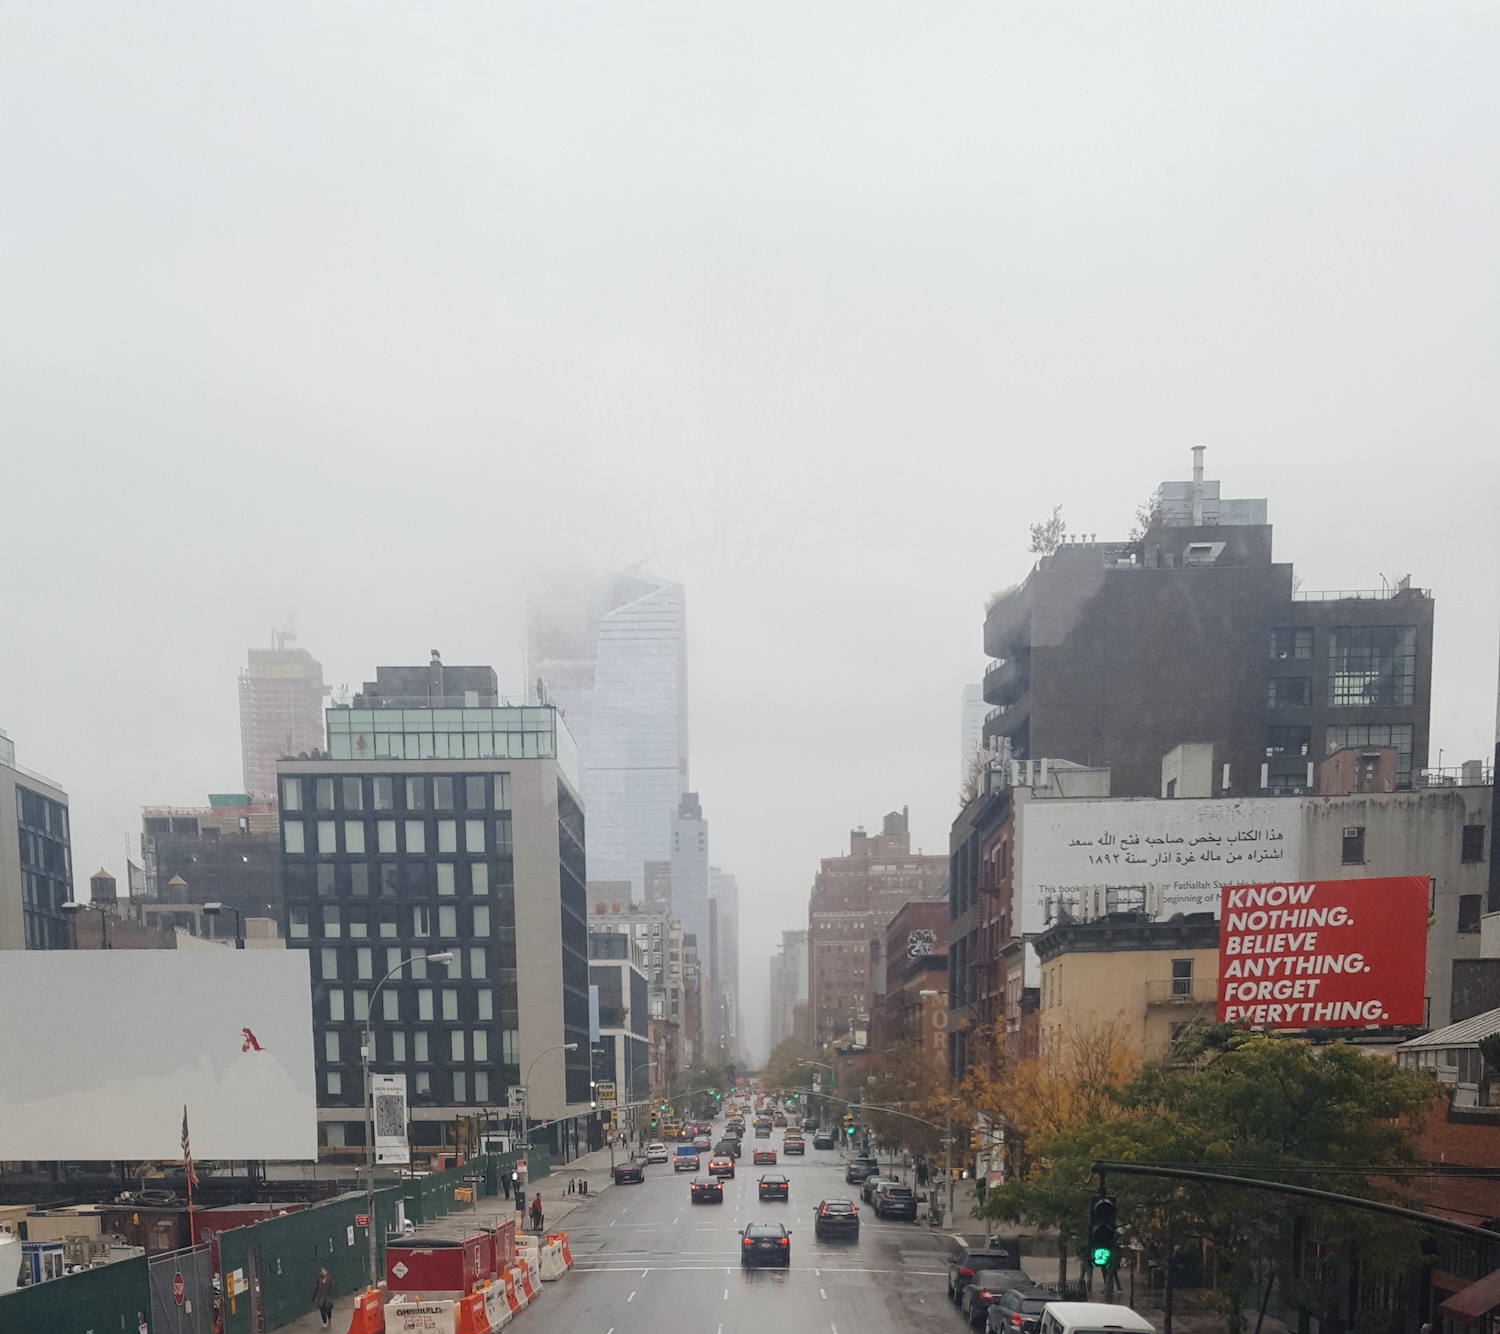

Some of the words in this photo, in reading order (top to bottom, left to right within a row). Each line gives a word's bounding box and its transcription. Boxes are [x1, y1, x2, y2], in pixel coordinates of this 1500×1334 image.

[1189, 832, 1221, 847] يخص
[1227, 829, 1261, 846] الكتاب
[1266, 829, 1283, 841] هذا
[1226, 852, 1242, 864] من
[1038, 884, 1056, 894] This
[1059, 884, 1081, 893] book
[1173, 881, 1211, 891] Fathallah
[1205, 892, 1214, 902] of
[1227, 884, 1316, 909] KNOW
[1226, 906, 1354, 932] NOTHING.
[1226, 932, 1318, 955] BELIEVE
[1224, 953, 1371, 978] ANYTHING.
[1224, 979, 1320, 1001] FORGET
[1225, 1000, 1389, 1023] EVERYTHING.
[173, 1283, 184, 1295] STOP
[396, 1307, 442, 1317] OMNIBUILD
